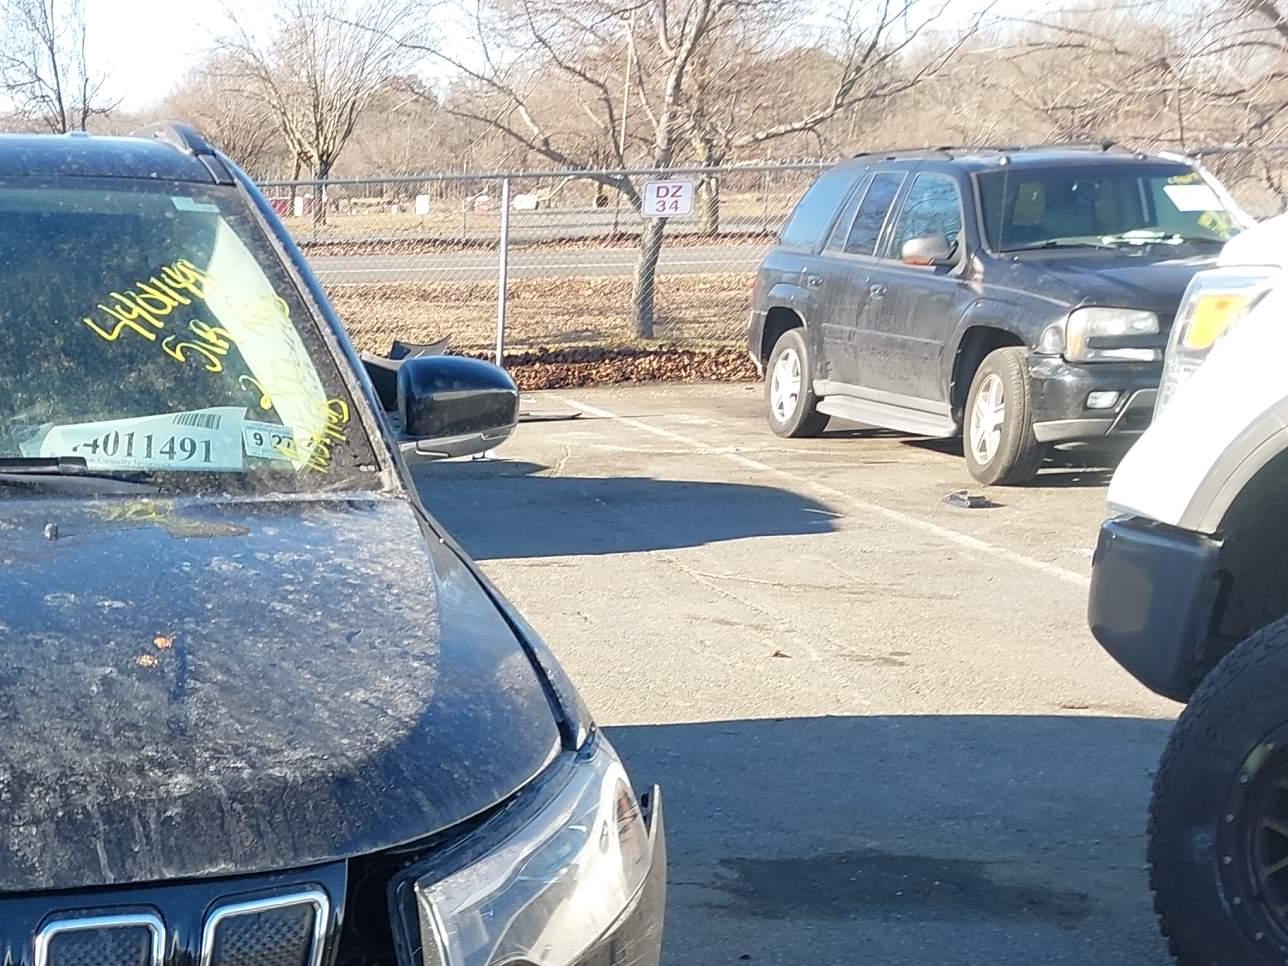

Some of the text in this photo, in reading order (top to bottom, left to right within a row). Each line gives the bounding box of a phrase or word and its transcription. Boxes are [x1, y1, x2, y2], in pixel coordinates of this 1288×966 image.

[656, 184, 683, 199] DZ
[655, 199, 680, 213] 34
[72, 430, 214, 463] 4011491
[253, 432, 264, 447] 9
